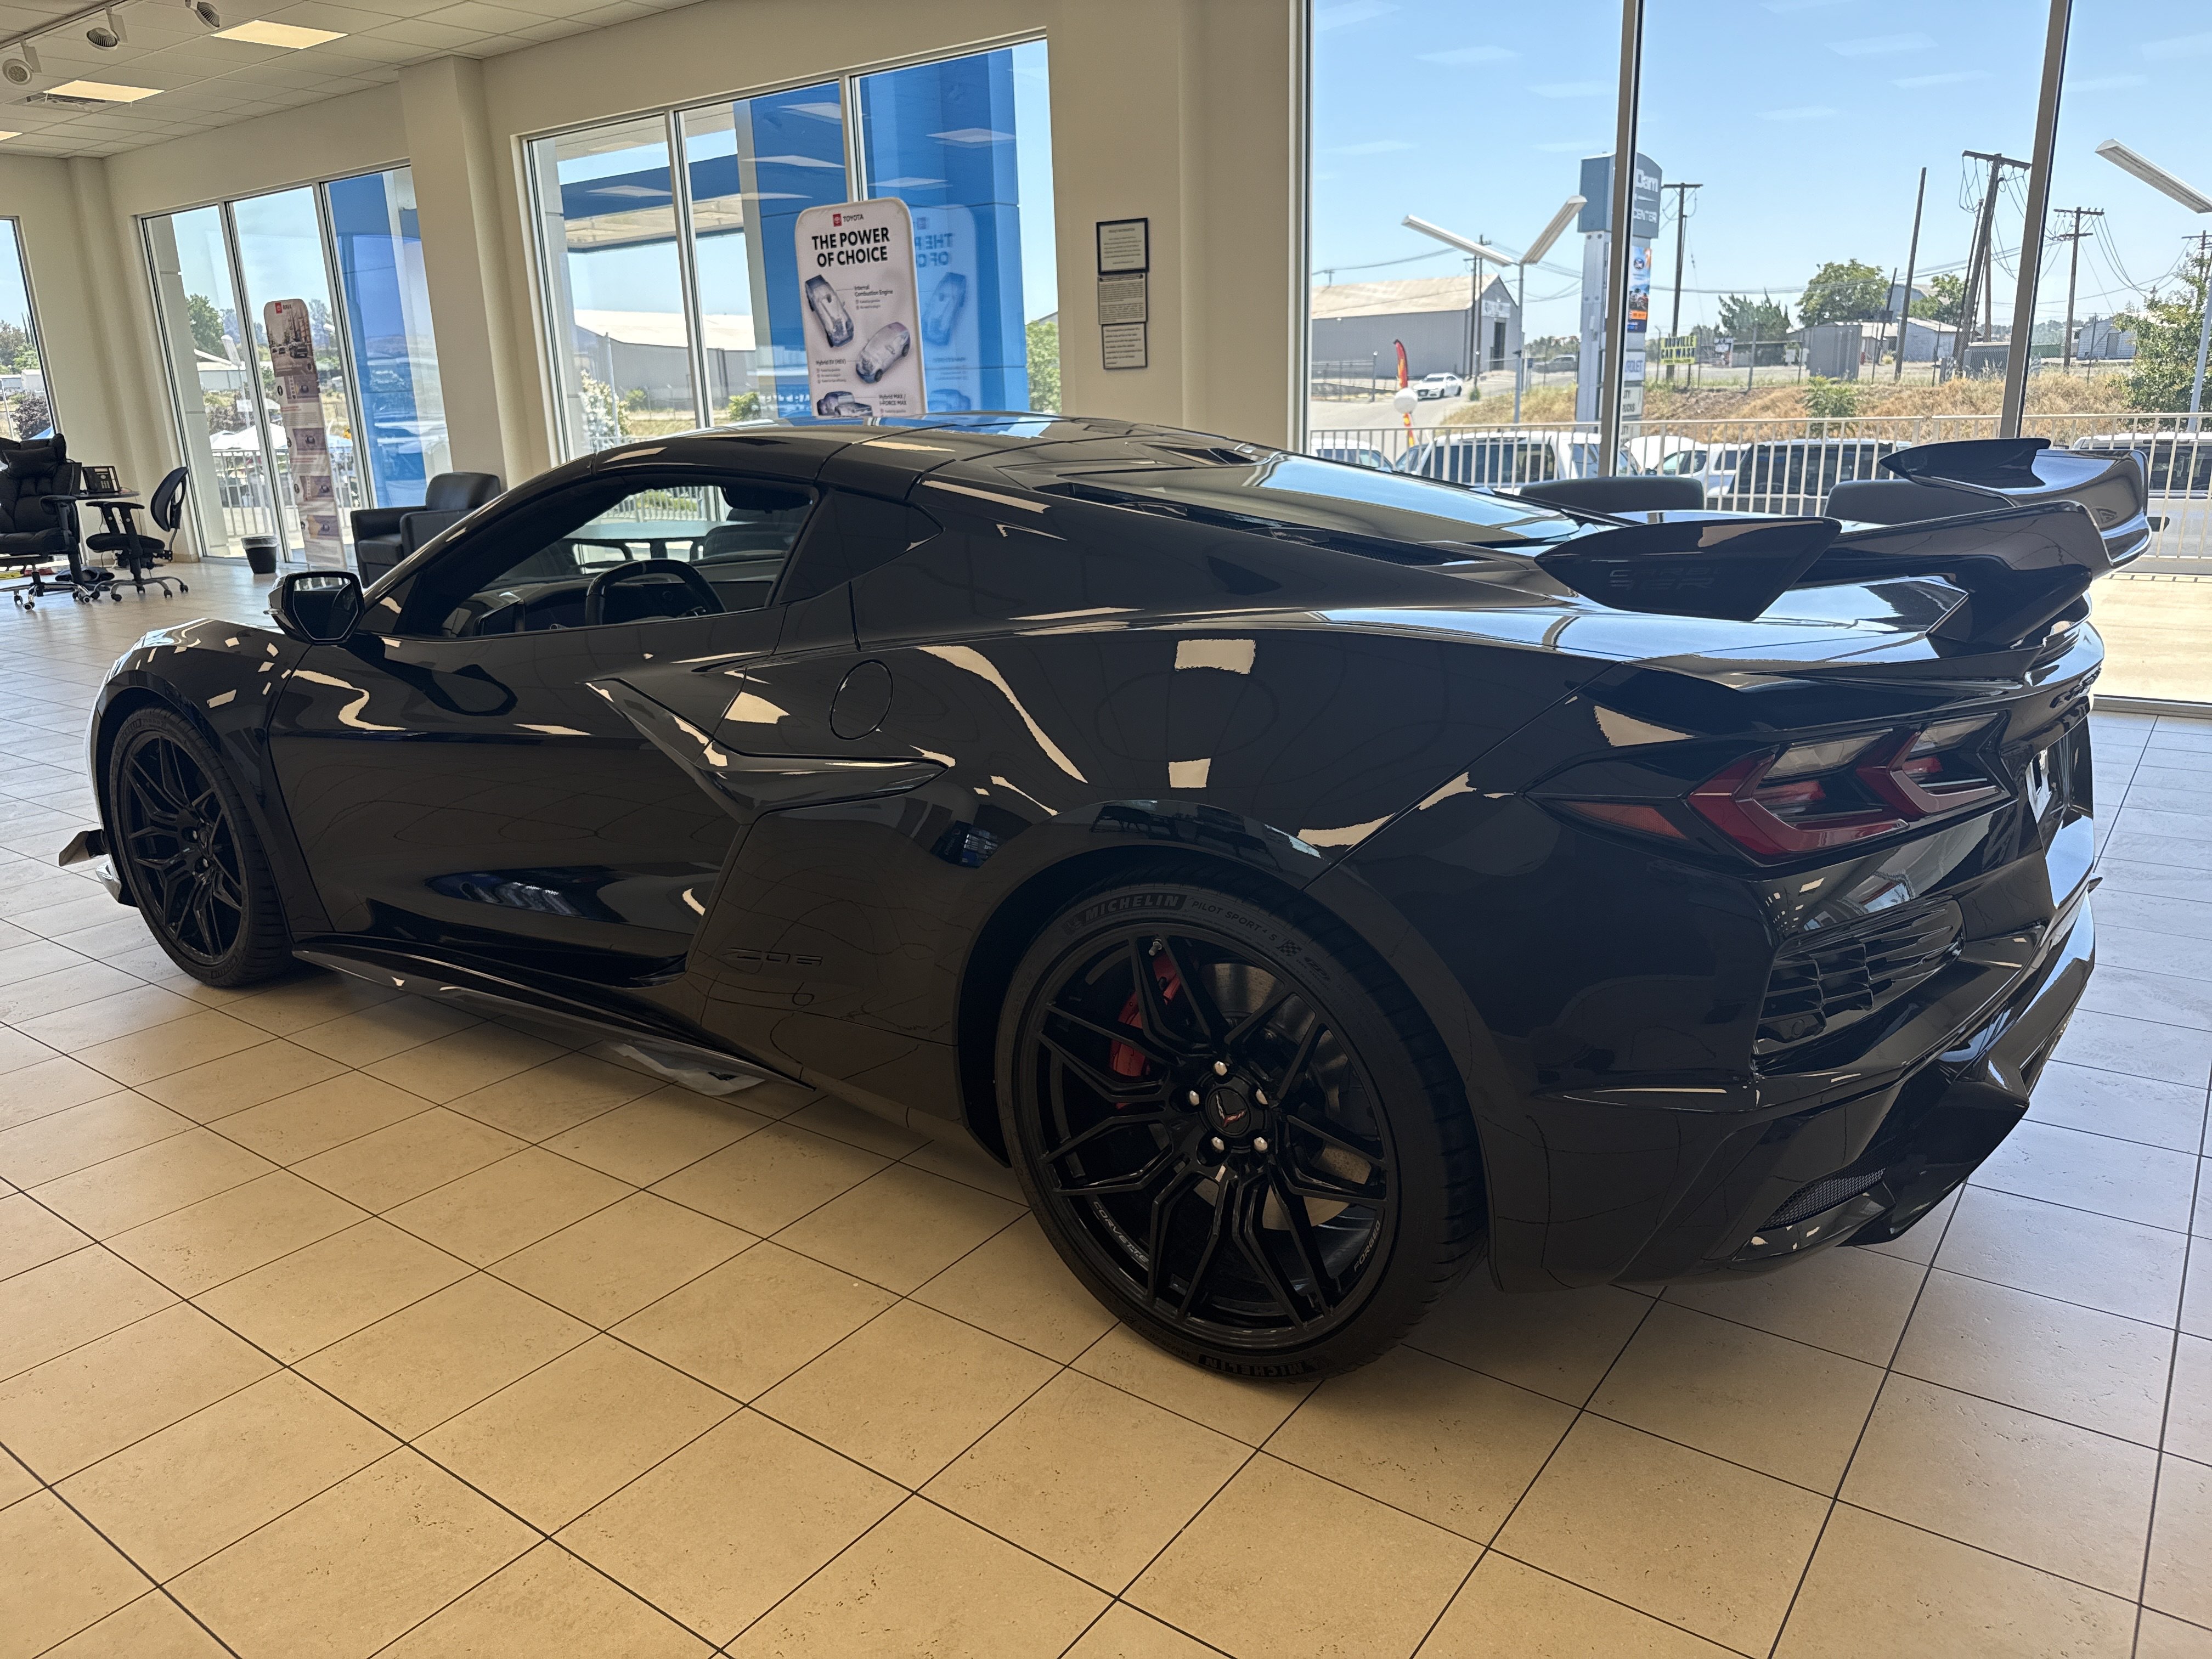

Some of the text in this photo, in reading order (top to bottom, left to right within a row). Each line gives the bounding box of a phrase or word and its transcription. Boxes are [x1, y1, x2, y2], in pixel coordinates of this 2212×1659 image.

[843, 214, 864, 222] TOYOTA
[812, 227, 890, 250] THE POWER
[817, 246, 888, 267] OF CHOICE
[1086, 895, 1179, 921] MICHELIN
[1192, 900, 1223, 915] PILOT
[1225, 911, 1263, 932] SPORT
[1093, 1201, 1149, 1262] CORVETTE
[1353, 1220, 1381, 1272] FORGED
[1205, 1357, 1305, 1376] MICHELIN
